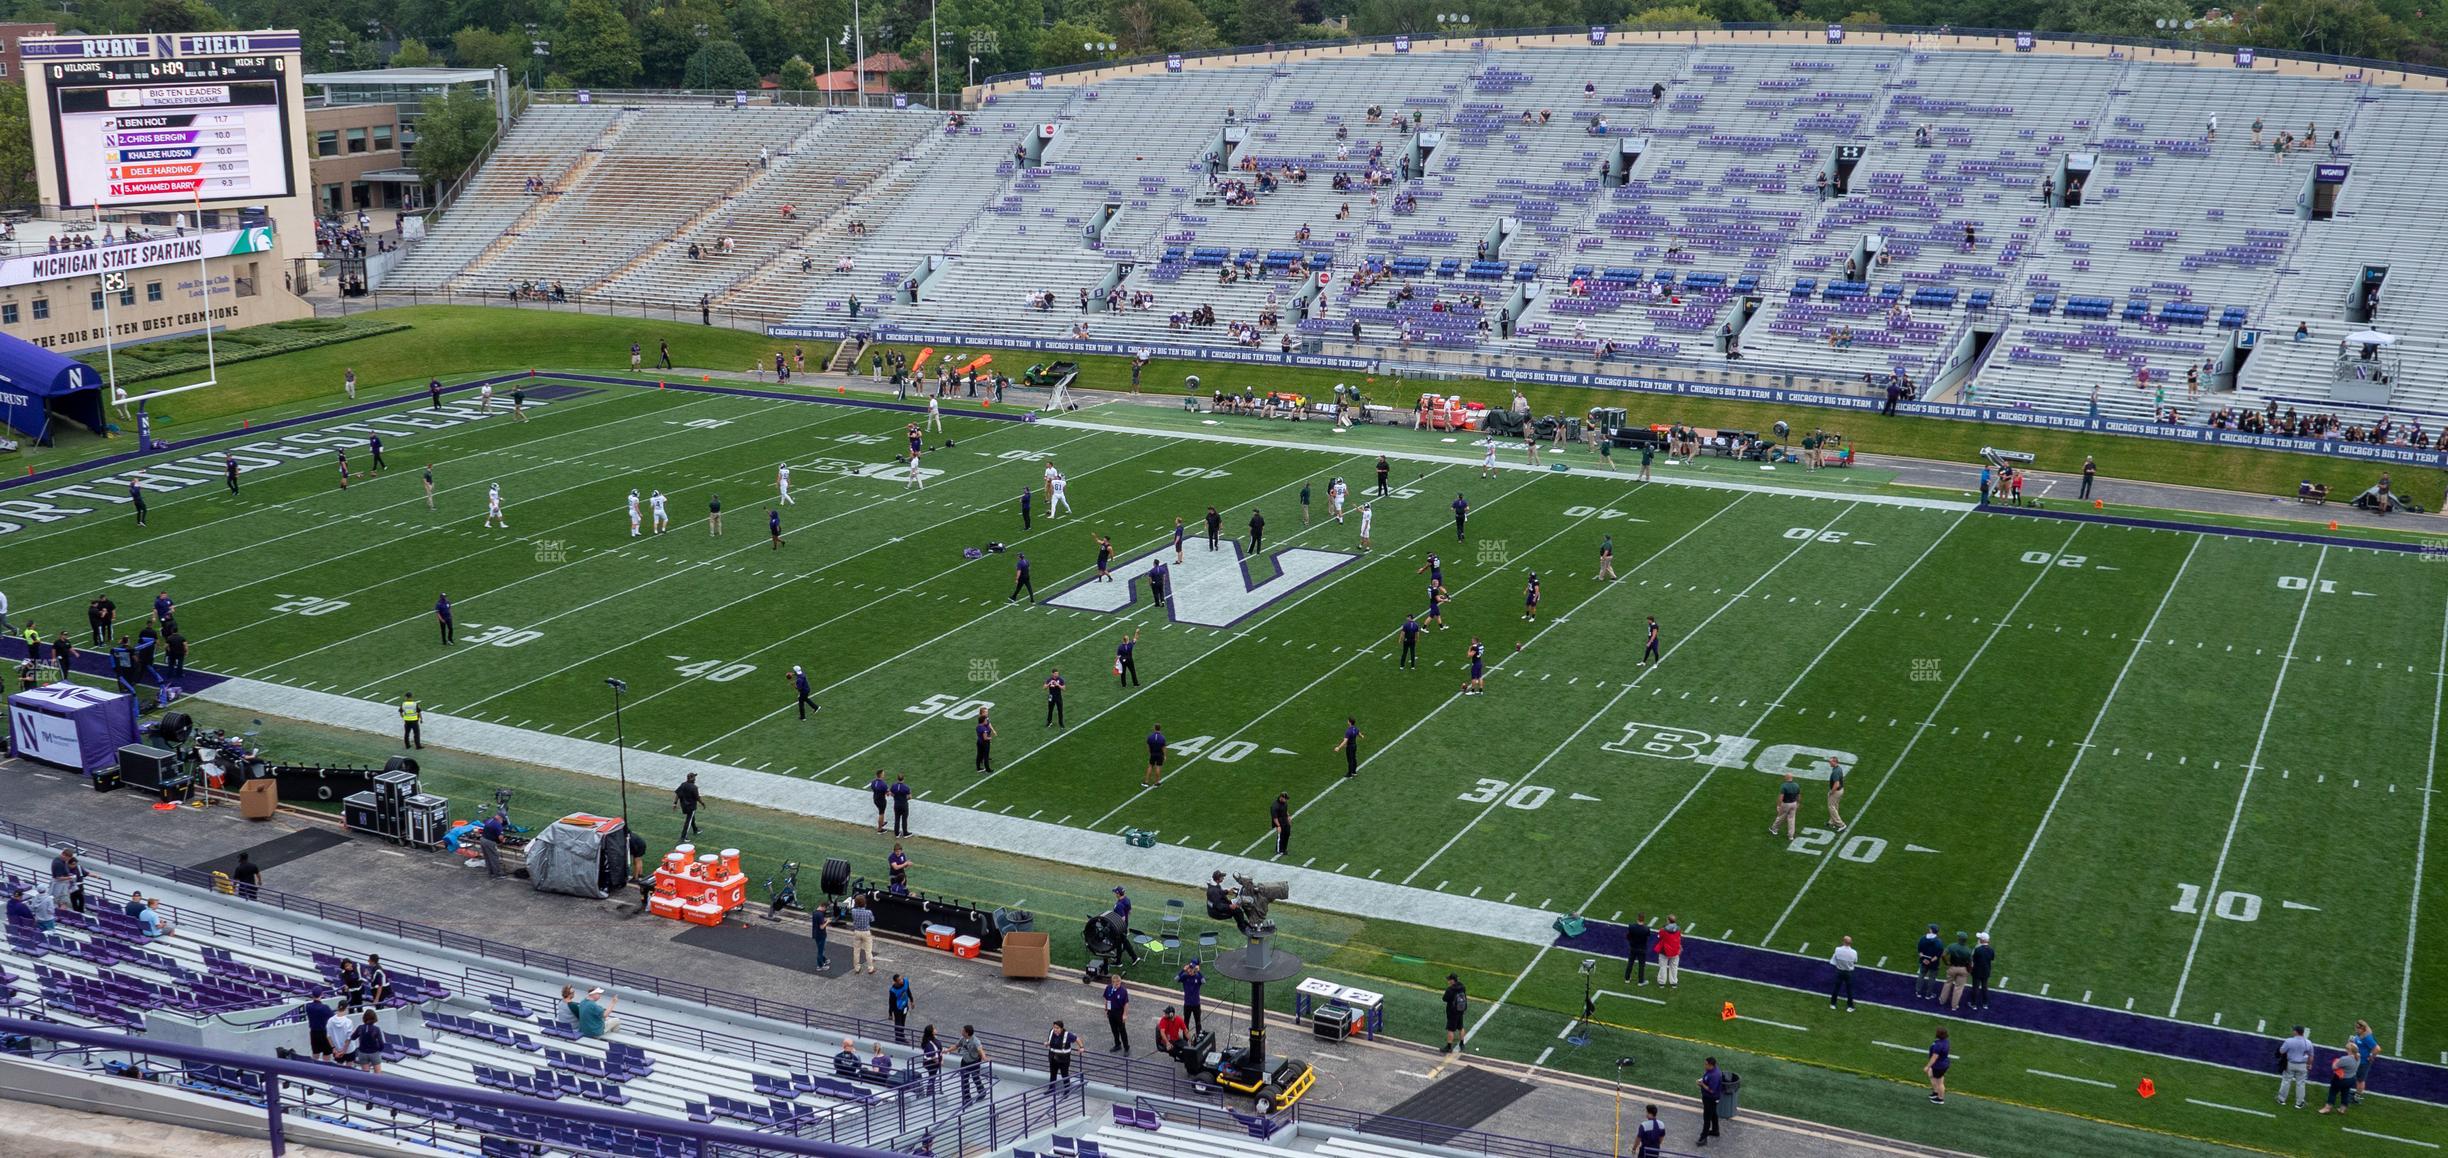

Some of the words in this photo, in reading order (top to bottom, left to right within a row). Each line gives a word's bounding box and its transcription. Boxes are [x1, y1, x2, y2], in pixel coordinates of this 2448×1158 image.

[1592, 32, 1604, 40] 107
[82, 39, 138, 57] RYAN
[192, 36, 249, 54] FIELD
[235, 58, 254, 66] MICH
[2240, 54, 2251, 63] 110
[64, 63, 100, 72] WILDCATS
[1030, 77, 1041, 86] 104
[125, 118, 143, 127] BEN
[145, 117, 167, 126] HOLT
[127, 135, 152, 144] CHRIS
[154, 134, 186, 142] BERGIN
[128, 151, 161, 159] KHALEKE
[162, 149, 192, 158] HUDSON
[130, 168, 152, 176] DELE
[154, 166, 193, 175] HARDING
[132, 183, 170, 192] MOHAMED
[172, 181, 196, 190] BARRY
[33, 253, 97, 278] MICHIGAN
[103, 248, 137, 268] STATE
[142, 239, 201, 263] SPARTANS
[105, 273, 124, 290] 25
[32, 335, 56, 348] THE
[60, 330, 88, 345] 2018
[116, 322, 138, 335] TEN
[143, 316, 173, 331] WEST
[178, 305, 239, 325] CHAMPIONS
[812, 330, 823, 338] TEN
[914, 334, 924, 342] BIG
[936, 335, 951, 343] TEAM
[965, 337, 993, 345] CHICAGO'S
[994, 338, 1003, 346] BIG
[1004, 339, 1014, 347] TEN
[1015, 340, 1031, 348] TEAM
[1045, 342, 1074, 350] CHICAGO'S
[1084, 343, 1096, 351] TEN
[1097, 344, 1112, 352] TEAM
[1180, 349, 1196, 357] TEAM
[1211, 351, 1241, 359] CHICAGO'S
[1253, 353, 1264, 361] TEN
[1265, 354, 1281, 362] TEAM
[1297, 357, 1326, 365] CHICAGO'S
[1327, 358, 1337, 366] BIG
[1351, 360, 1368, 368] TEAM
[69, 368, 82, 389] N
[1533, 373, 1544, 381] BIG
[1545, 373, 1557, 382] TEN
[1559, 374, 1576, 383] TEAM
[2356, 366, 2366, 380] N
[1595, 377, 1626, 387] CHICAGO'S
[1627, 380, 1638, 388] BIG
[1639, 381, 1653, 389] TEN
[1654, 382, 1672, 390] TEAM
[1690, 385, 1723, 394] CHICAGO'S
[1724, 388, 1736, 396] BIG
[1737, 388, 1750, 397] TEN
[1751, 390, 1770, 398] TEAM
[1789, 393, 1823, 403] CHICAGO'S
[1824, 396, 1836, 404] BIG
[1837, 397, 1851, 406] TEN
[1852, 399, 1871, 408] TEAM
[1928, 406, 1939, 414] BIG
[1942, 406, 1955, 415] TEN
[1957, 408, 1976, 417] TEAM
[1996, 411, 2033, 423] CHICAGO'S
[2034, 415, 2047, 424] BIG
[2049, 416, 2062, 425] TEN
[2064, 418, 2085, 428] TEAM
[2106, 422, 2144, 433] CHICAGO'S
[2146, 426, 2158, 435] BIG
[2160, 427, 2174, 436] TEN
[2177, 428, 2198, 439] TEAM
[2219, 432, 2260, 445] CHICAGO'S
[2261, 437, 2274, 447] BIG
[2277, 438, 2292, 449] TEN
[2294, 440, 2316, 450] TEAM
[2338, 444, 2380, 457] CHICAGO'S
[2381, 449, 2395, 460] BIG
[2398, 451, 2413, 461] TEN
[2416, 453, 2438, 463] TEAM
[104, 569, 176, 588] 10
[270, 596, 351, 616] 20
[460, 625, 545, 648] 30
[674, 659, 757, 682] 40
[904, 693, 995, 721] 50
[18, 711, 39, 752] N
[1166, 735, 1259, 763] 40
[1457, 778, 1556, 810] 30
[1787, 827, 1888, 863] 20
[2170, 882, 2262, 922] 10
